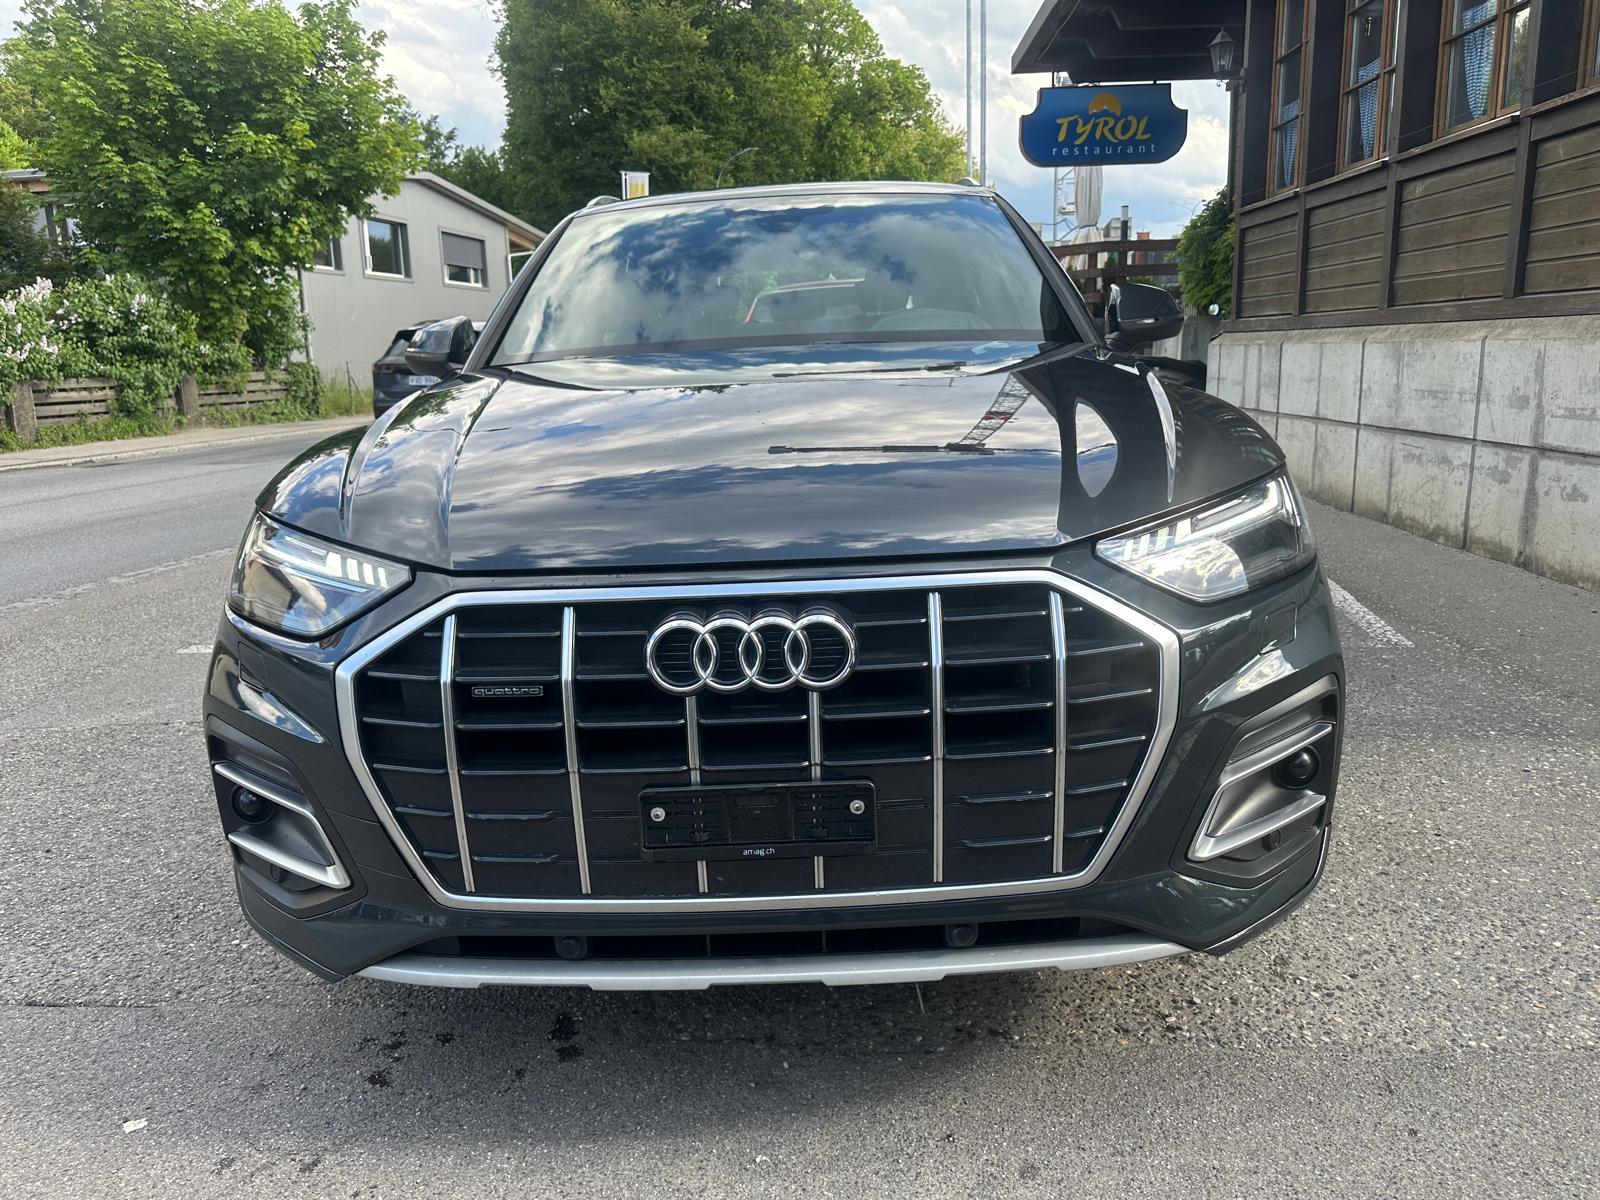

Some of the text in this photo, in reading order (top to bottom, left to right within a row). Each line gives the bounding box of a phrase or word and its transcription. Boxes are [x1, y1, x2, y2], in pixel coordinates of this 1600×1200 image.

[1056, 114, 1151, 145] TYROL
[1052, 143, 1156, 156] restaurant
[474, 687, 539, 696] quattro
[742, 847, 776, 857] amag.ch
